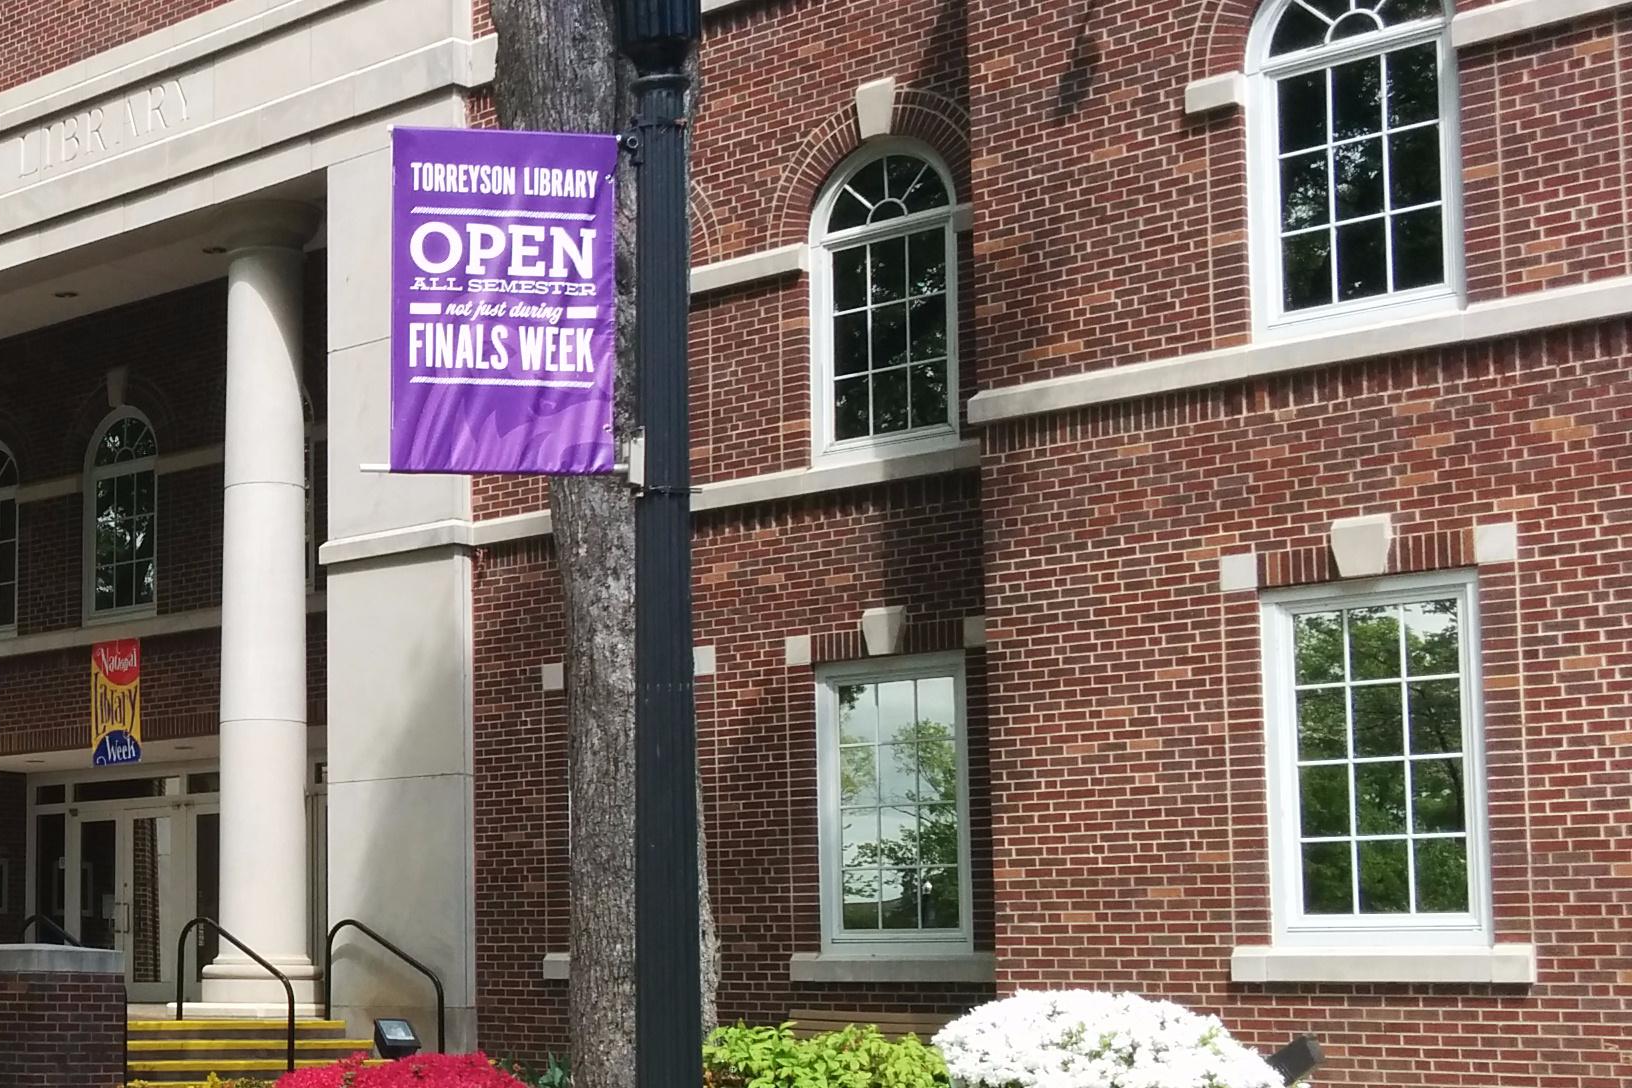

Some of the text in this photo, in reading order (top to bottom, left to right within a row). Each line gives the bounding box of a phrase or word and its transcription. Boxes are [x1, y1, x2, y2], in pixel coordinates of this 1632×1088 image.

[18, 75, 195, 178] LIBRARY
[411, 162, 598, 198] TORREYSON LIBRARY
[410, 221, 597, 279] OPEN
[410, 277, 597, 296] ALL SEMESTER
[445, 300, 563, 325] not just during
[409, 323, 594, 372] FINALS WEEK
[97, 645, 137, 676] National
[94, 673, 137, 736] Library
[98, 733, 137, 765] Week
